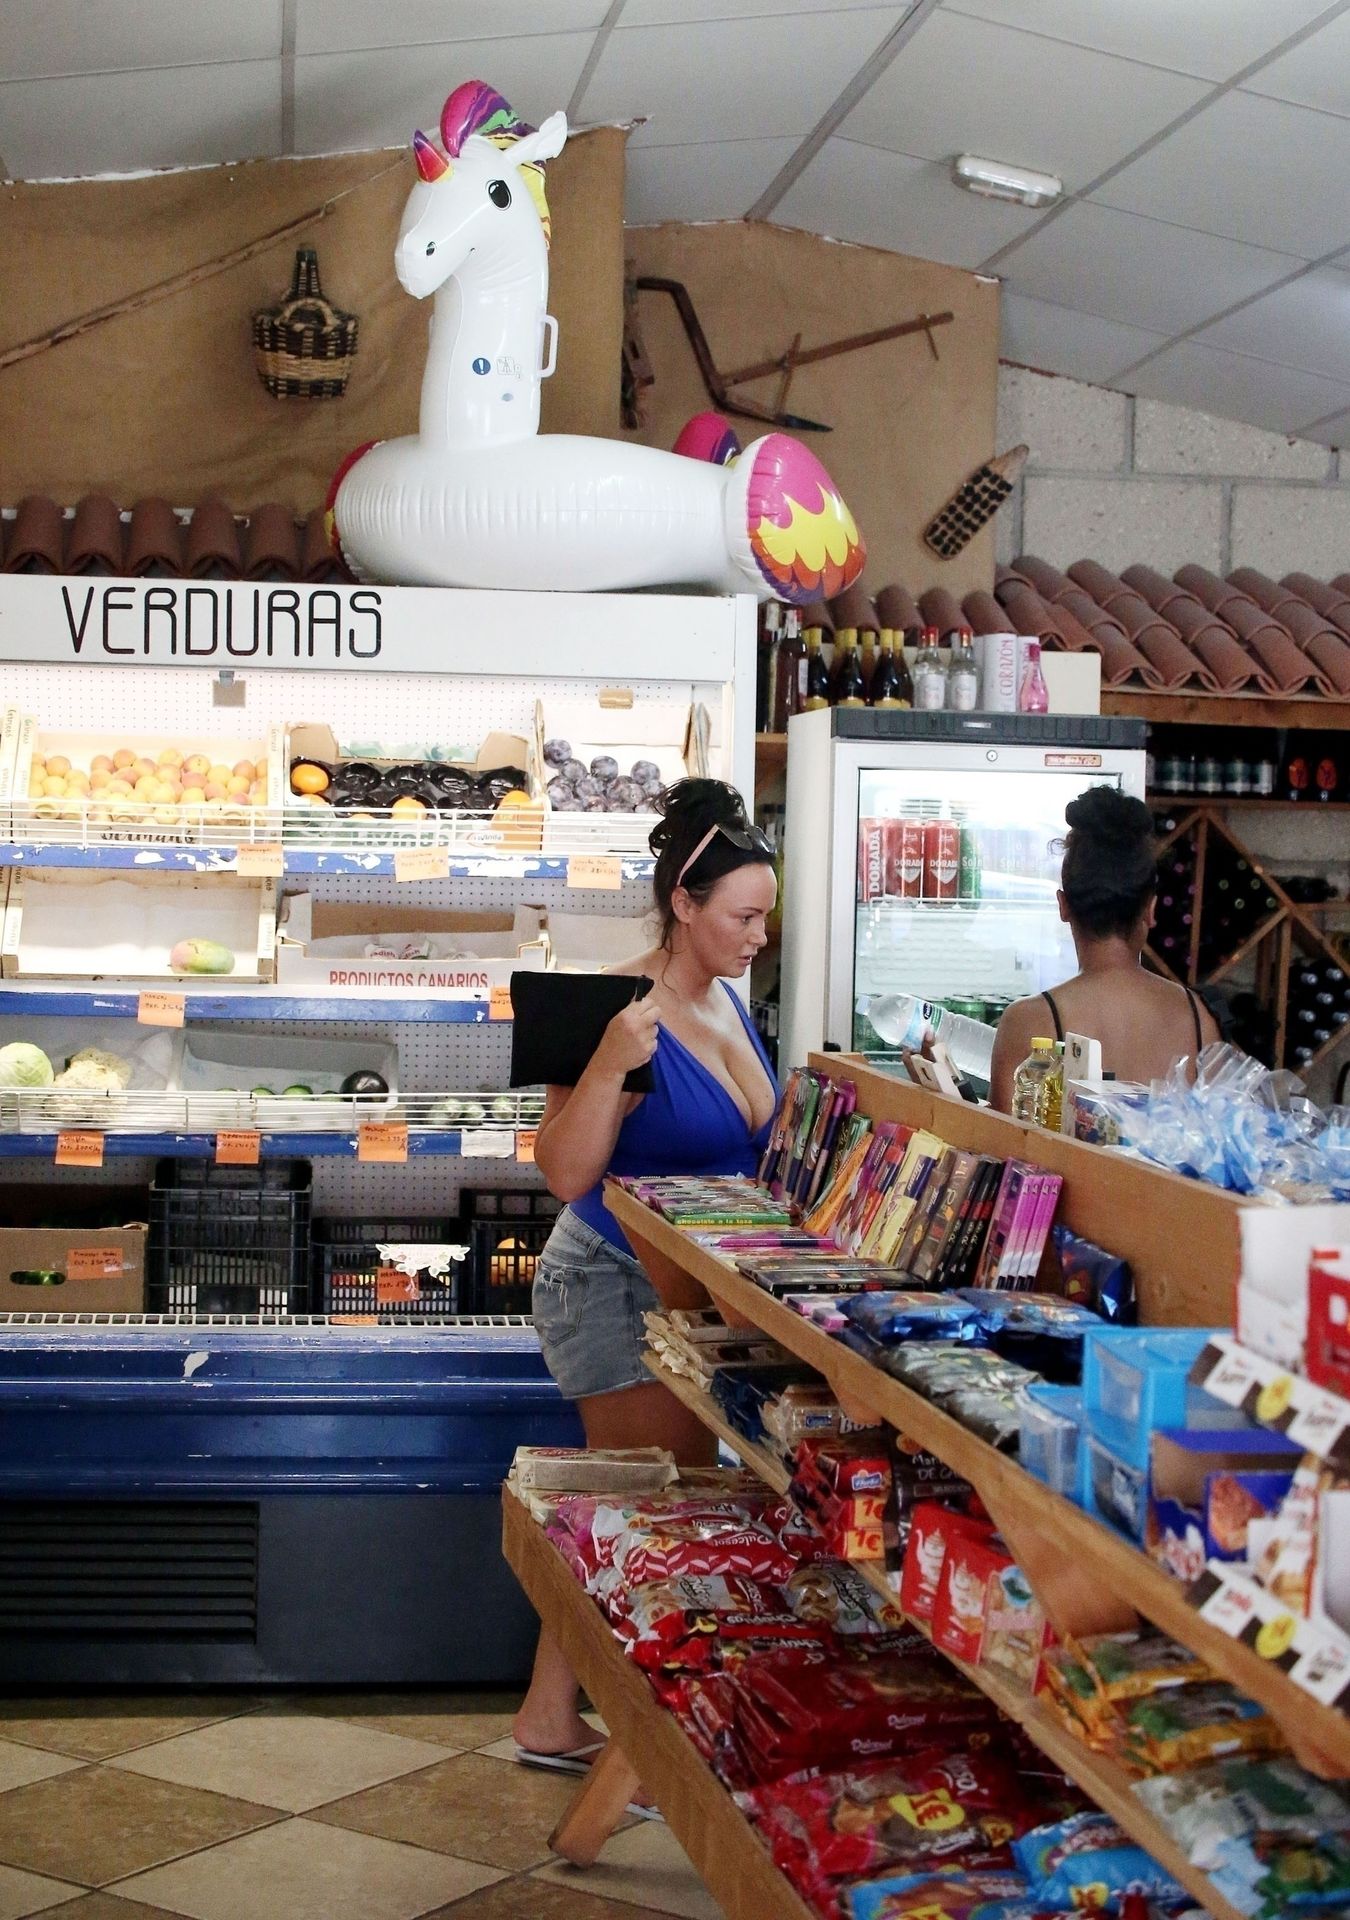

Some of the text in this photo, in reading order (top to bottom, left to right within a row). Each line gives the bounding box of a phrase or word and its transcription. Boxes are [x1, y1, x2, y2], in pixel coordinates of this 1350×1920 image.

[61, 585, 383, 658] VERDURAS
[868, 830, 882, 893] DORADA
[329, 970, 488, 988] PRODUCTOS CANARIOS
[713, 1533, 773, 1548] Dulcesol
[854, 1530, 881, 1551] 1€
